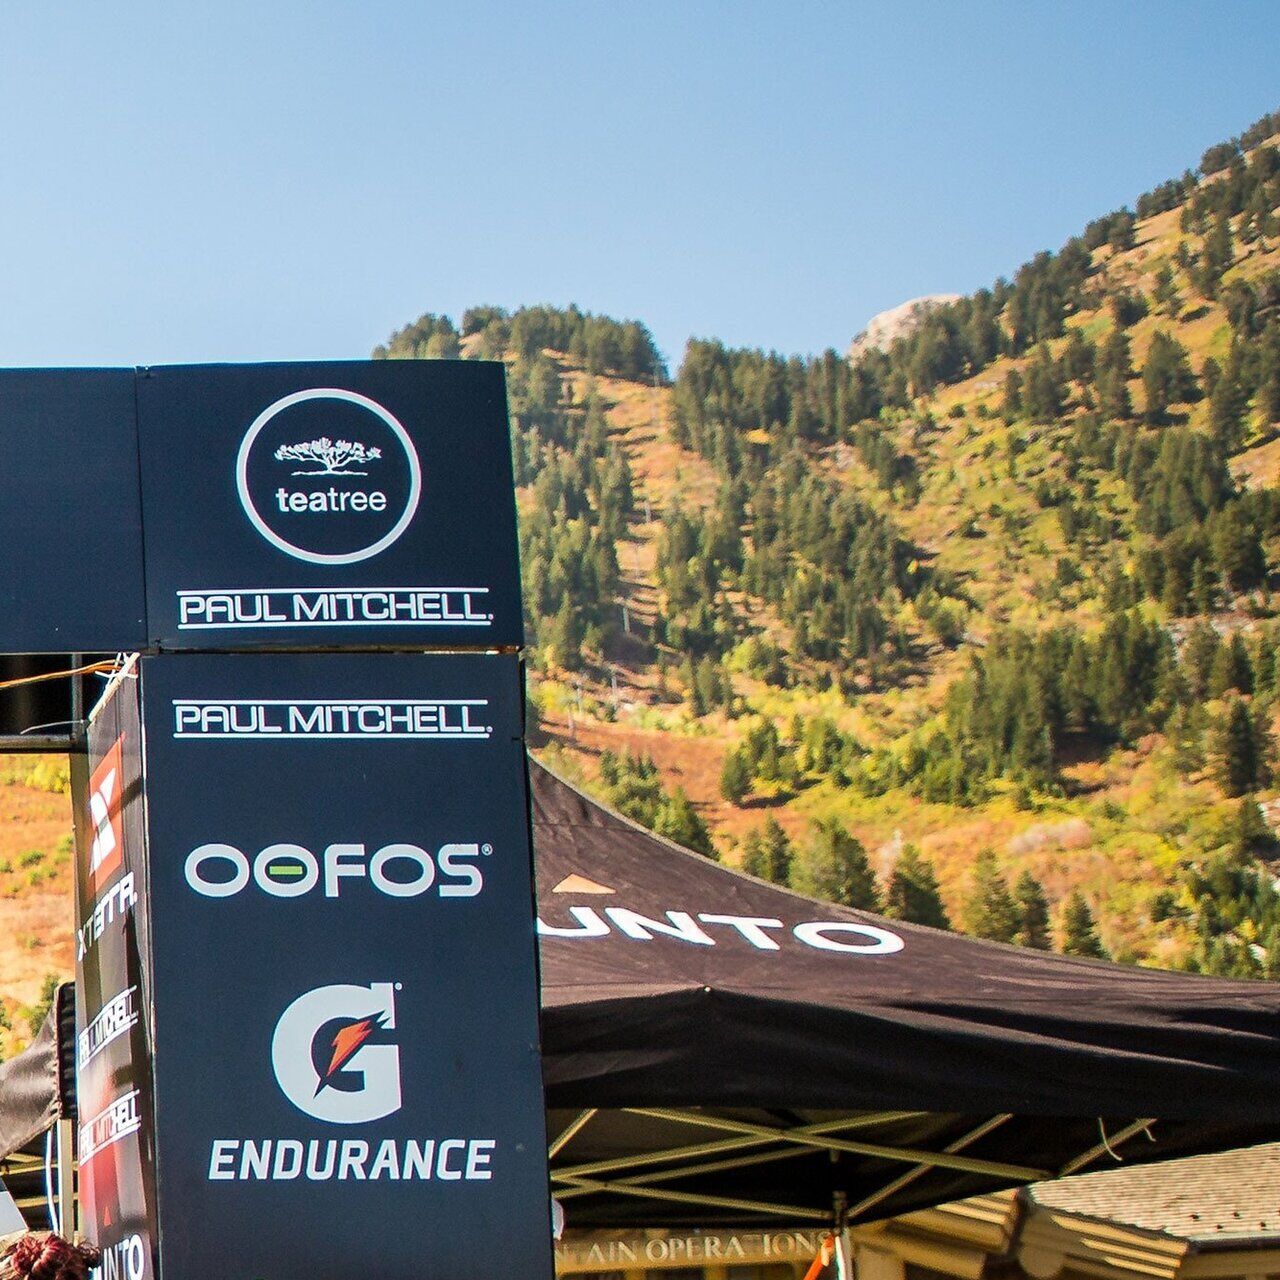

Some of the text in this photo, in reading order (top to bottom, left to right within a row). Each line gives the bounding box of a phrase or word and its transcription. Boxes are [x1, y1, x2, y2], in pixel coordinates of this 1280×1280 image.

[274, 487, 387, 513] teatree
[179, 592, 485, 624] PAUL MITCHELL
[175, 705, 485, 733] PAUL MITCHELL
[183, 843, 484, 898] OOFOS
[536, 905, 906, 956] UNTO
[208, 1139, 497, 1181] ENDURANCE
